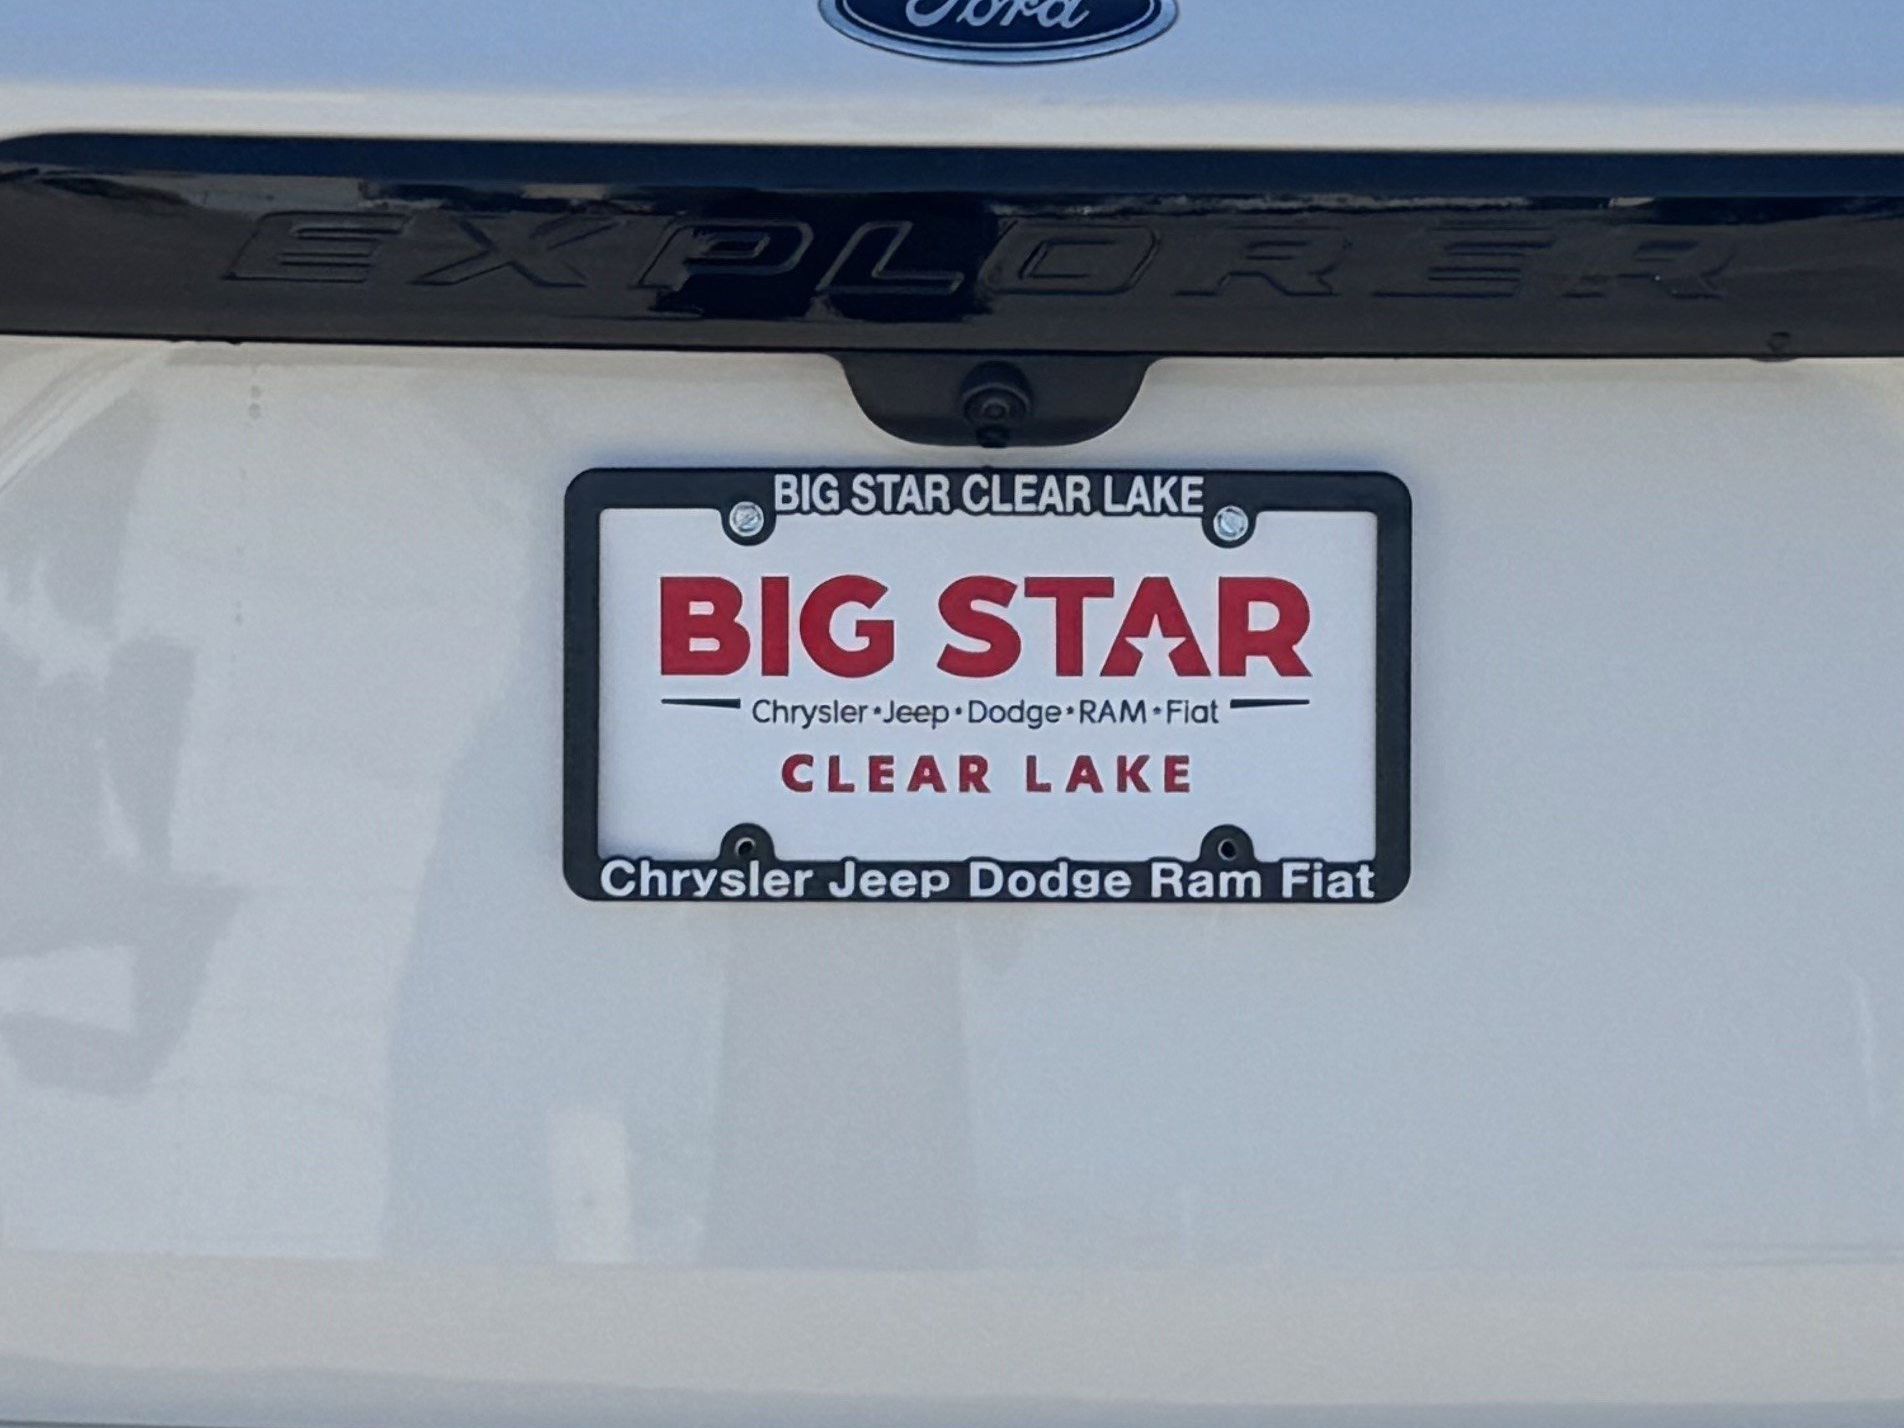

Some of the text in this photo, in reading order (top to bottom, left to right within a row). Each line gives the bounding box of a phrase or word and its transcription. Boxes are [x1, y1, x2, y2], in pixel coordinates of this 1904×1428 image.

[221, 208, 1738, 299] EXPLORER
[773, 473, 1205, 513] BIG STAR CLEAR LAKE
[660, 575, 1312, 678] BIG STAR
[781, 753, 1192, 794] CLEAR LAKE
[599, 859, 1376, 899] Chrysler Jeep Dodge Ram Fiat
